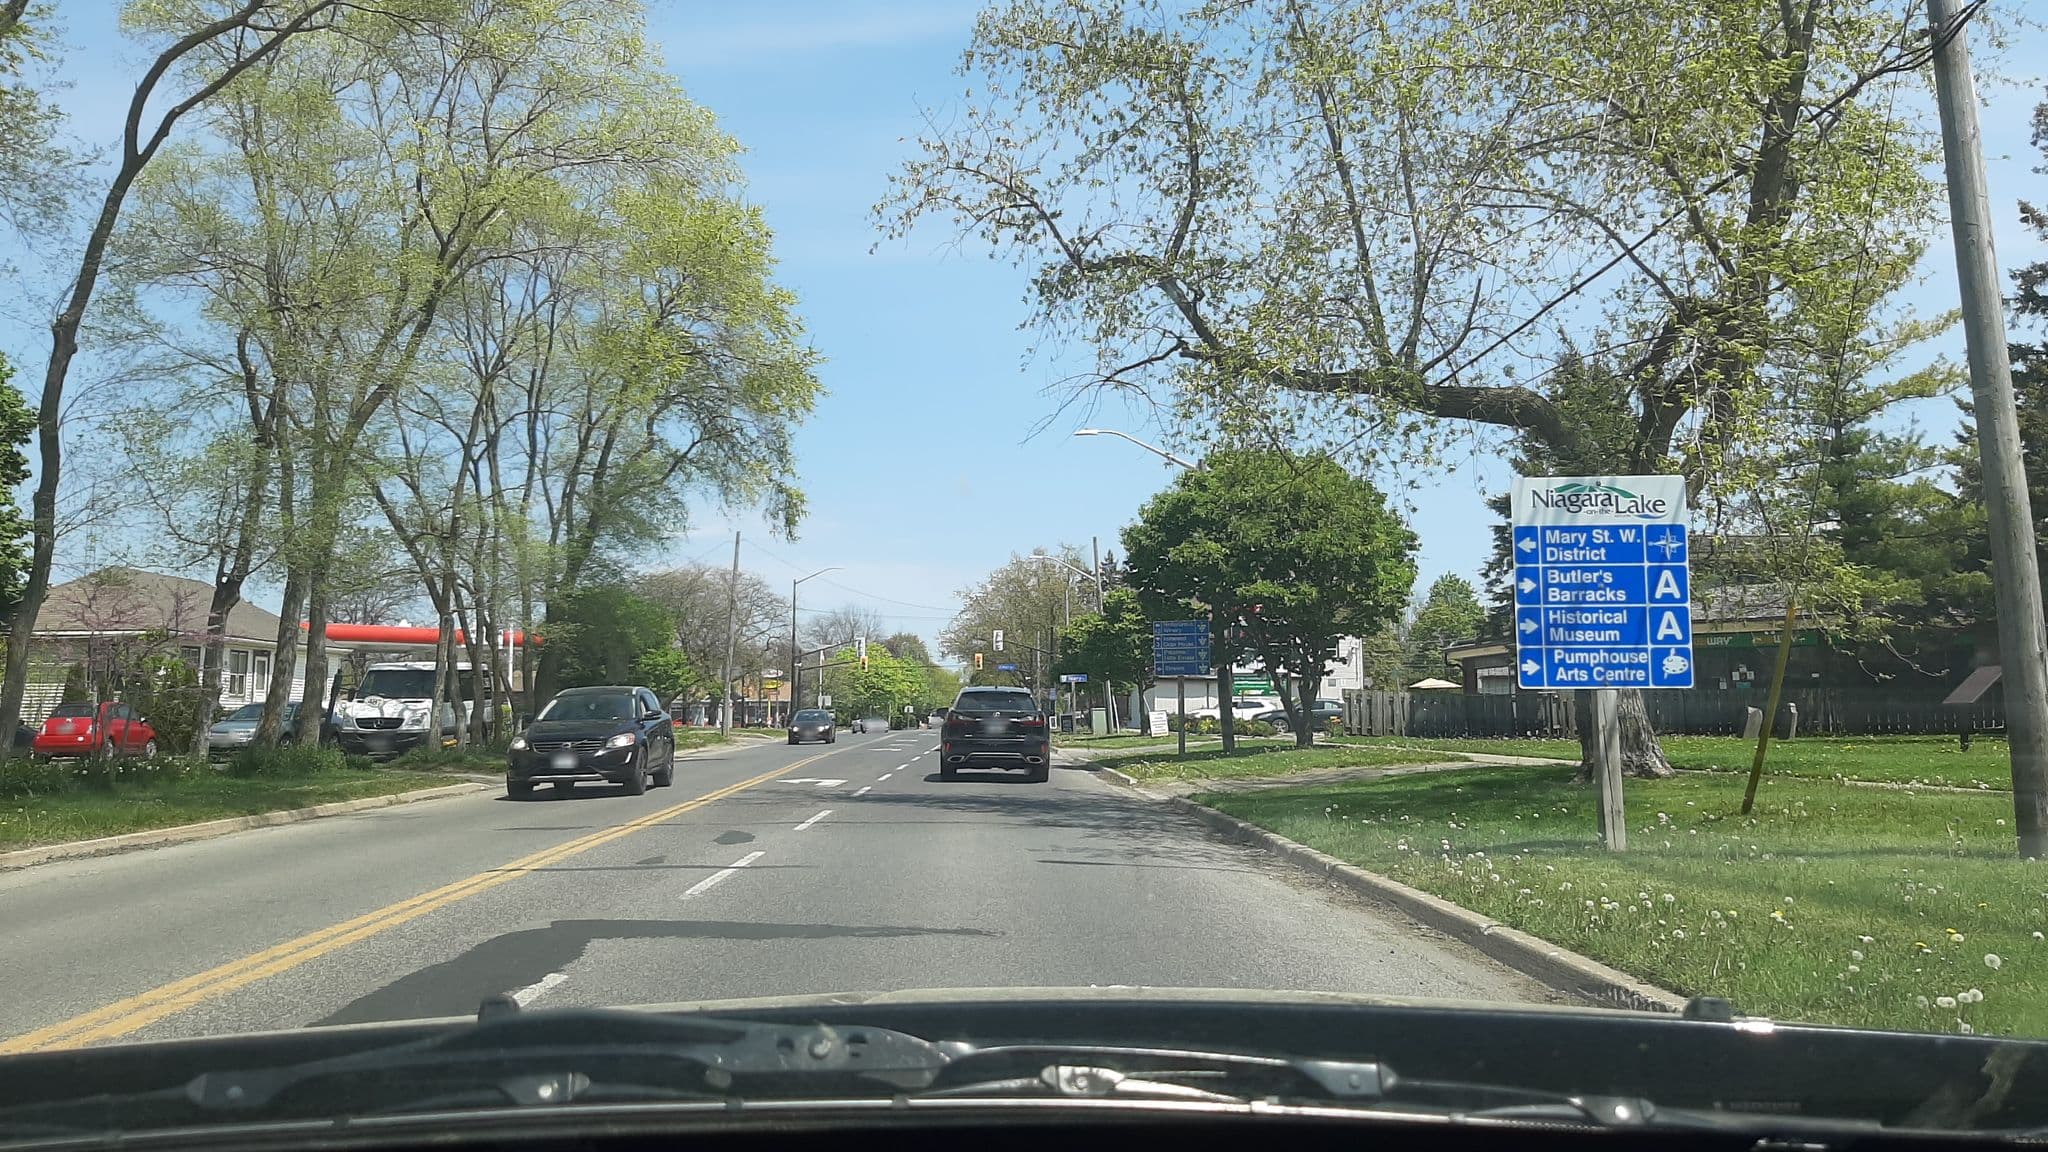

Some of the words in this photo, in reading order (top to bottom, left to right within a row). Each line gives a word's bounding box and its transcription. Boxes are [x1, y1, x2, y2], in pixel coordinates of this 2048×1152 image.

[1531, 489, 1614, 514] Niagara
[1615, 492, 1666, 514] Lake
[1546, 529, 1587, 546] Mary
[1591, 529, 1615, 544] St.
[1619, 529, 1641, 544] W.
[1546, 547, 1607, 561] District
[1547, 569, 1613, 584] Butler's
[1548, 587, 1626, 602] Barracks
[1549, 609, 1628, 624] Historical
[1550, 627, 1620, 642] Museum
[1554, 649, 1648, 667] Pumphouse
[1556, 667, 1589, 682] Arts
[1593, 667, 1646, 682] Centre
